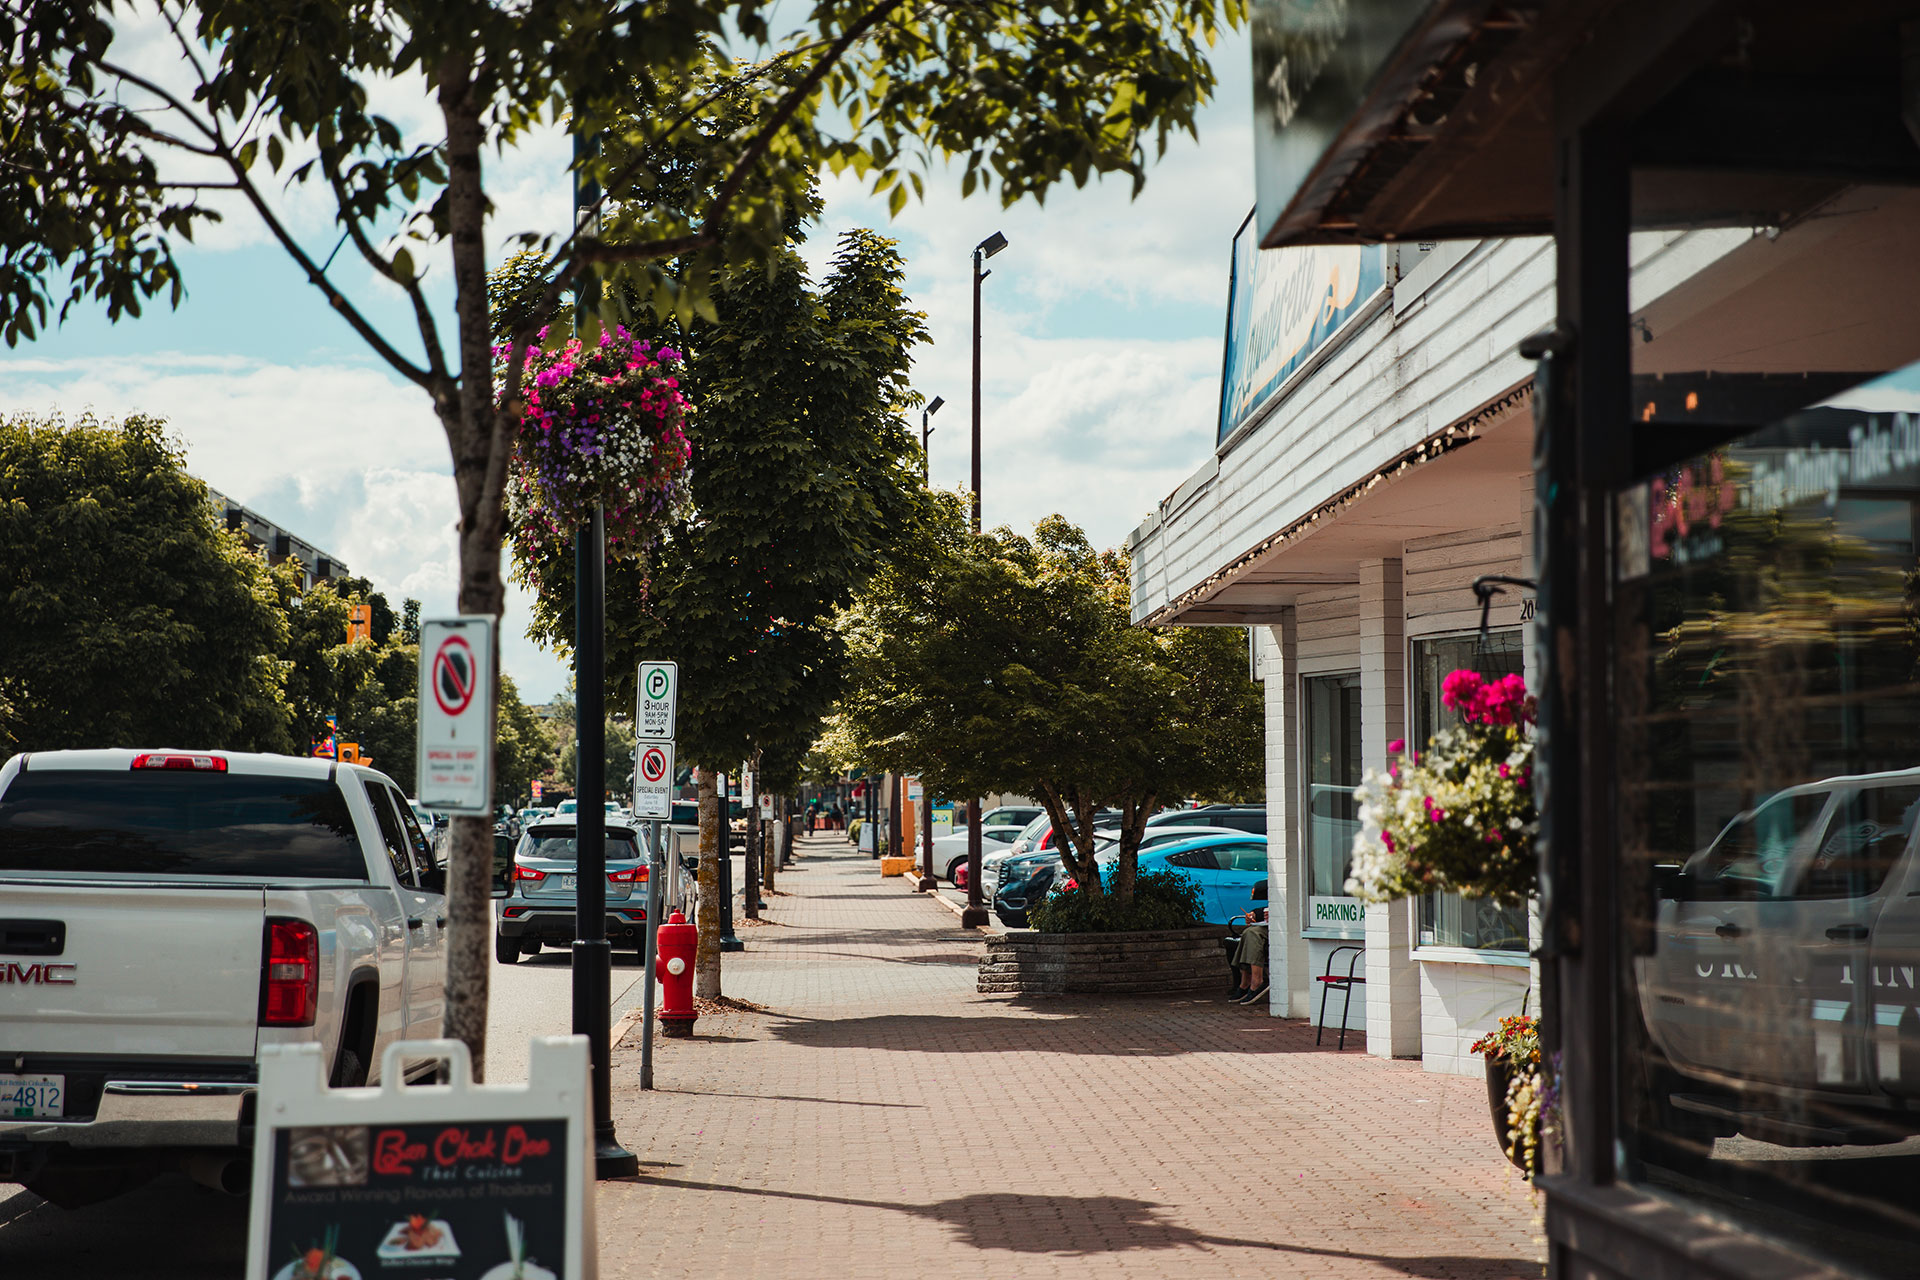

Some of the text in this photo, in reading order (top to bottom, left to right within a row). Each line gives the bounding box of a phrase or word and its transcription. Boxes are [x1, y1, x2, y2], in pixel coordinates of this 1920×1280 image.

[653, 676, 664, 693] P
[644, 700, 669, 711] 3 HOUR
[637, 785, 669, 795] SPECIAL EVENT
[1316, 904, 1357, 922] PARKING
[0, 961, 77, 985] MC
[13, 1087, 60, 1108] 4812
[502, 1125, 551, 1165] Dee
[423, 1164, 522, 1180] Thai Cuisine
[284, 1181, 553, 1204] Award Winning Flavours of Thailand
